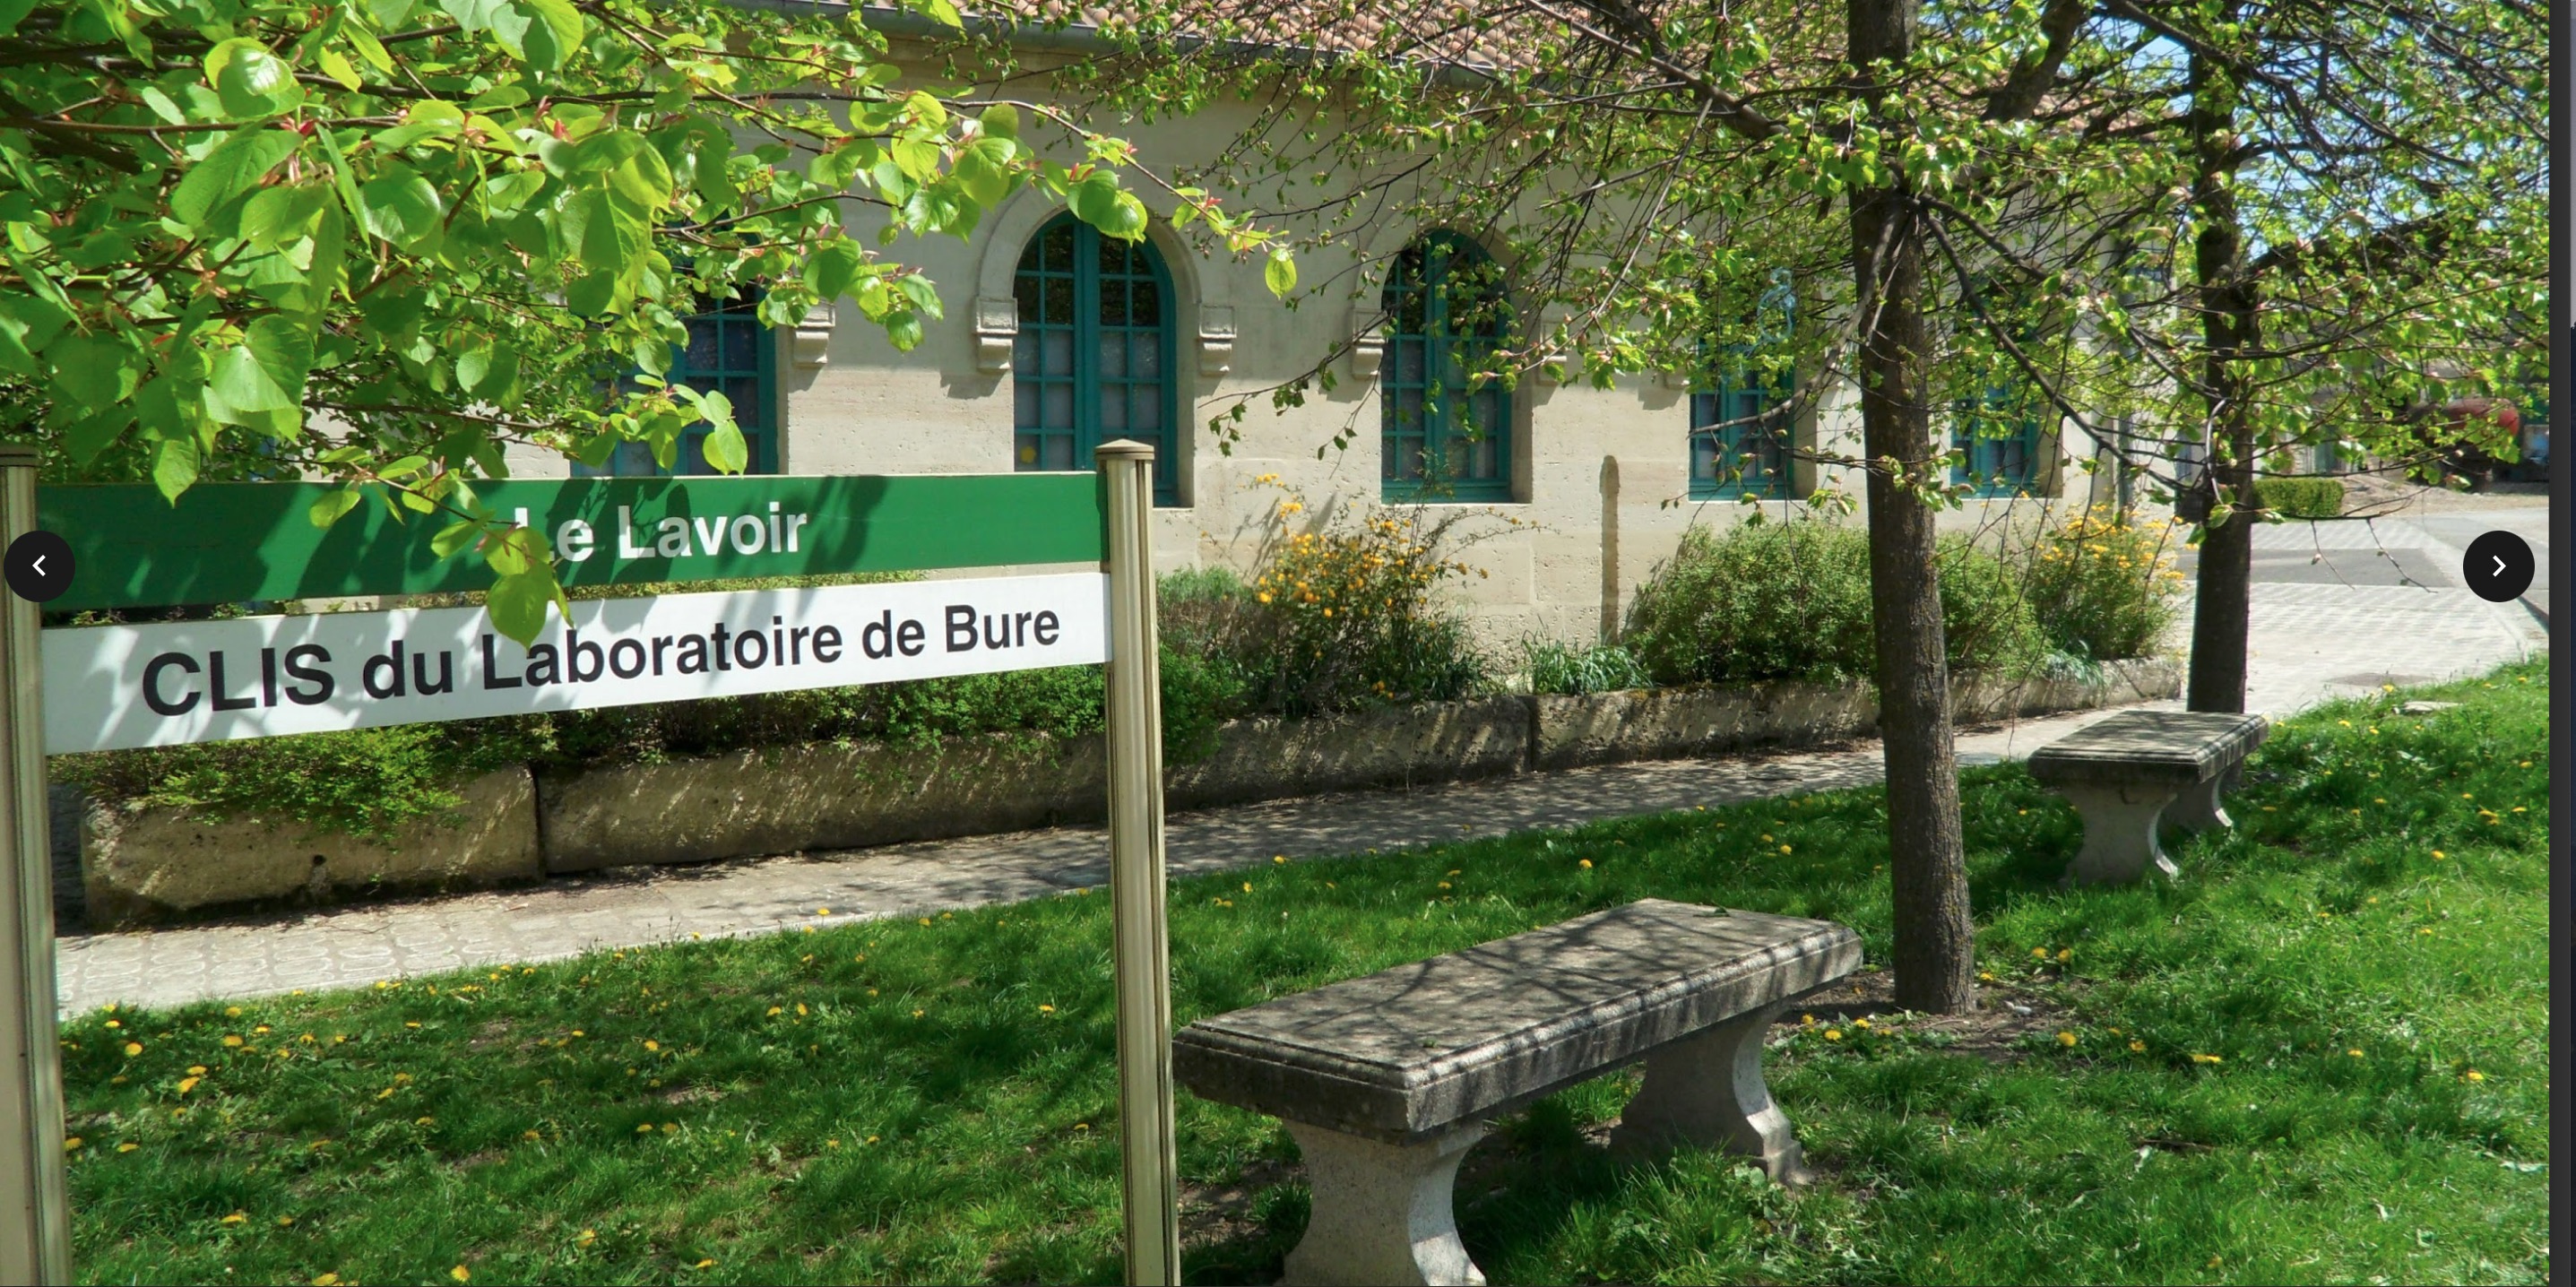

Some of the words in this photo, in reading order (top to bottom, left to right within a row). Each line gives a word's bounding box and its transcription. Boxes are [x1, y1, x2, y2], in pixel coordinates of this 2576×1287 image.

[618, 501, 808, 559] Lavoir
[142, 644, 335, 716] CLIS
[362, 639, 454, 700] du
[481, 616, 842, 690] Laboratoire
[862, 609, 925, 660] de
[946, 605, 1059, 652] Bure
